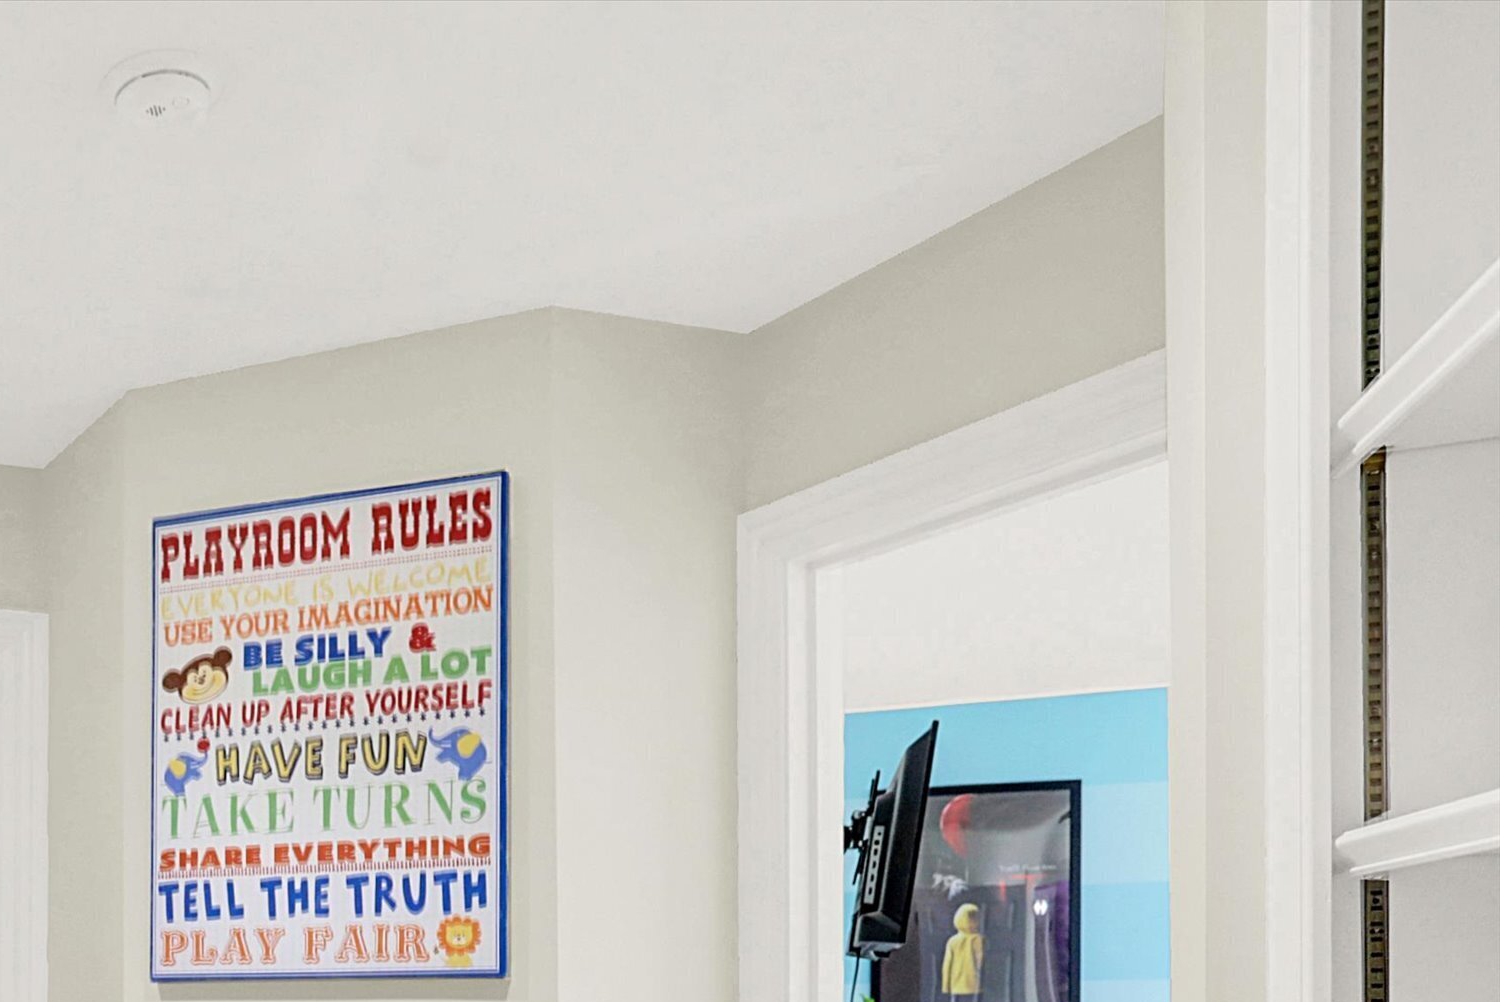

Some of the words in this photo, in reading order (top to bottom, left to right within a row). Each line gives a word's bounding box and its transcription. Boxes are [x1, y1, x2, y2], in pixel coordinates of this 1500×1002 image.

[161, 507, 351, 583] PLAYROOM
[371, 487, 493, 555] RULES
[161, 580, 297, 620] EVERYONE
[312, 577, 336, 602] IS
[350, 556, 490, 594] WELCOME
[163, 618, 213, 647] USE
[220, 606, 290, 639] YOUR
[298, 584, 493, 631] IMAGINATION
[243, 638, 283, 671] BE
[295, 626, 392, 666] SILLY
[408, 621, 437, 654] &
[252, 659, 372, 697] LAUGH
[383, 654, 409, 684] A
[420, 646, 493, 681] LOT
[160, 703, 231, 735] CLEAN
[241, 699, 270, 728] UP
[280, 690, 355, 725] AFTER
[365, 679, 493, 717] YOURSELF
[215, 735, 323, 785] HAVE
[338, 728, 427, 779] FUN
[161, 787, 295, 840] TAKE
[312, 777, 487, 831] TURNS
[159, 844, 261, 873] SHARE
[274, 833, 491, 865] EVERYTHING
[158, 879, 244, 923] TELL
[260, 874, 330, 921] THE
[346, 869, 487, 917] TRUTH
[160, 926, 285, 966] PLAY
[303, 922, 431, 964] FAIR
